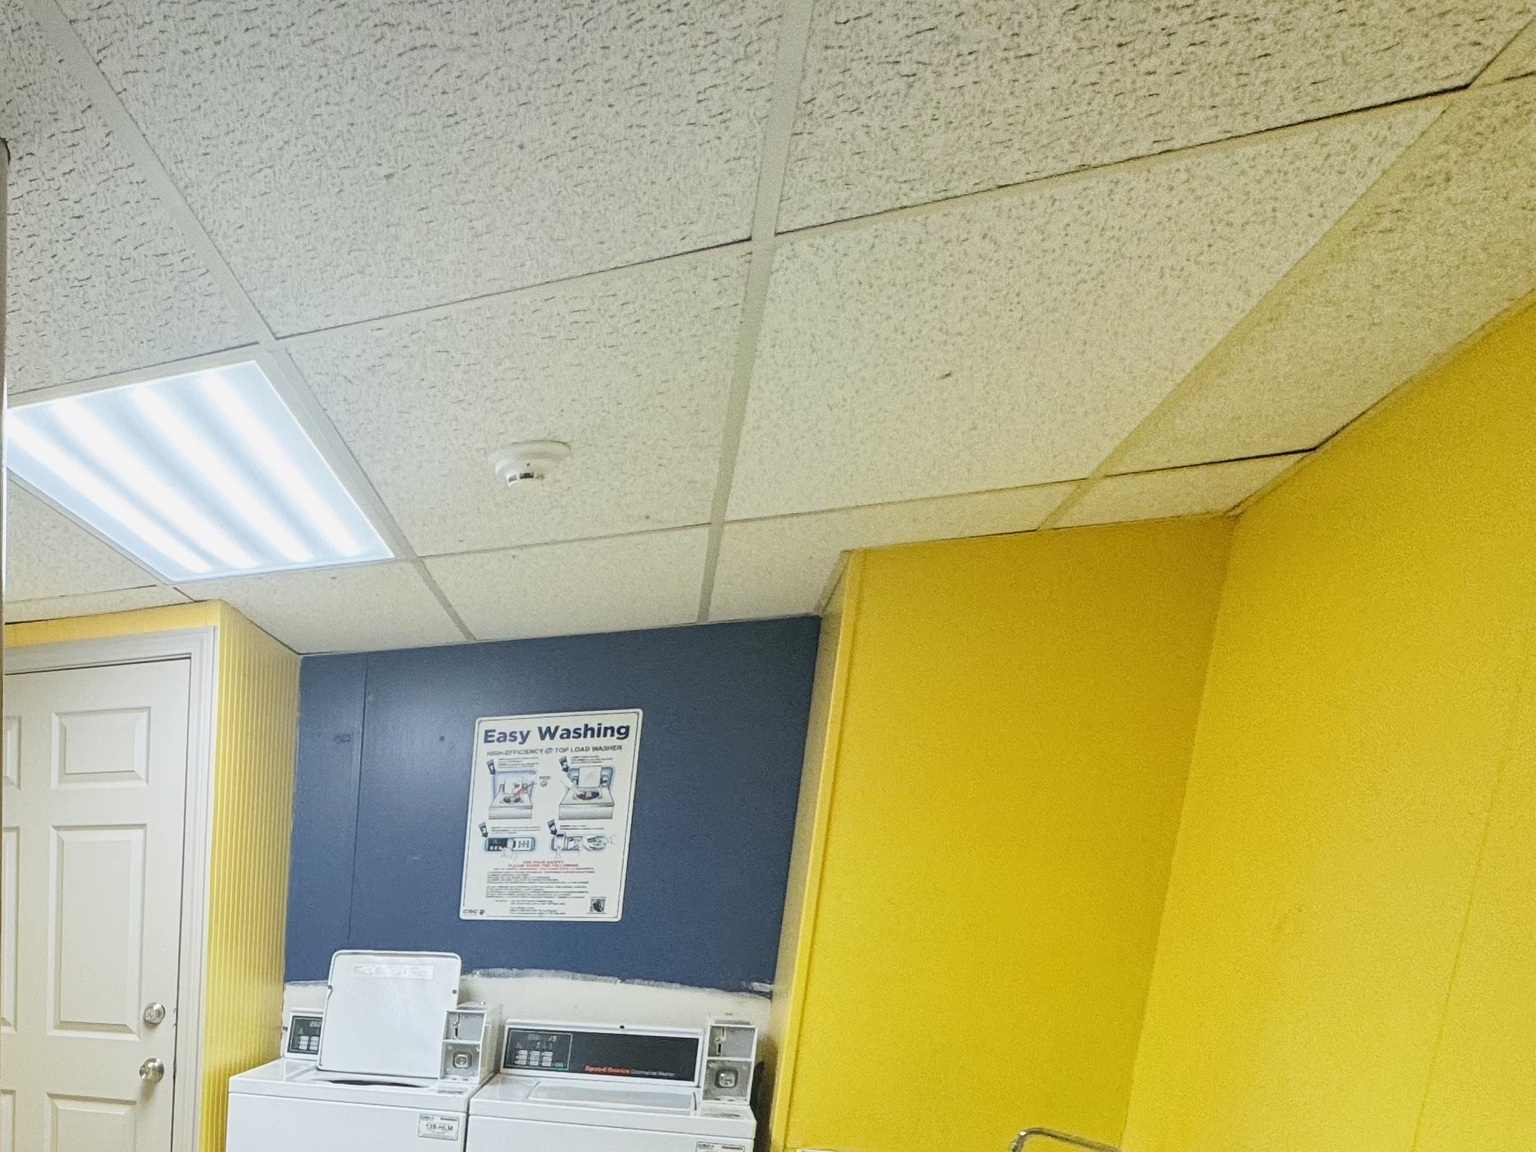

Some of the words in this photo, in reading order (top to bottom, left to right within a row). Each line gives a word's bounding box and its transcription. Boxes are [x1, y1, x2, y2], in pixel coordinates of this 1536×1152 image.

[483, 729, 531, 745] Easy
[537, 723, 631, 740] Washing
[570, 746, 590, 754] LOAD
[591, 744, 623, 752] WASHER
